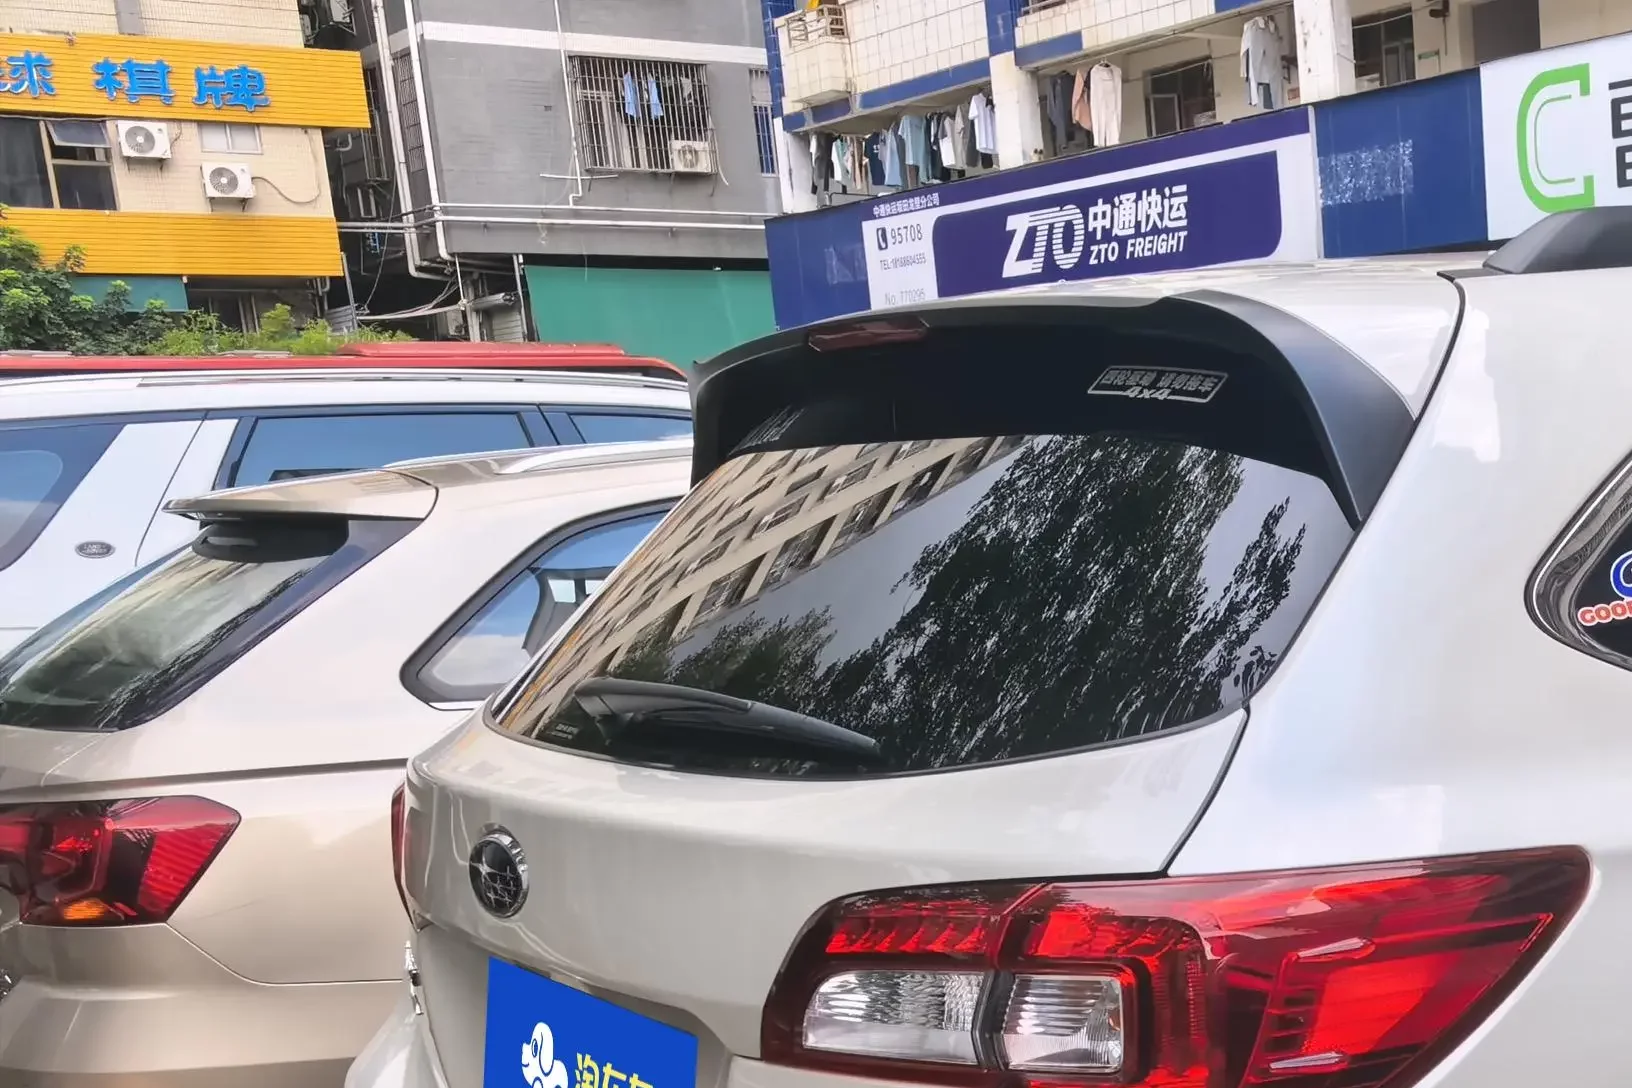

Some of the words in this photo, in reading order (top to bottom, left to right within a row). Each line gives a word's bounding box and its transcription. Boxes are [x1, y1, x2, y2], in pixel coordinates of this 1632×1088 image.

[890, 223, 923, 245] 95708
[1088, 184, 1188, 240] 中通快运
[1002, 204, 1085, 278] ZTO
[1089, 243, 1119, 265] ZTO
[1126, 231, 1188, 259] FREIGHT
